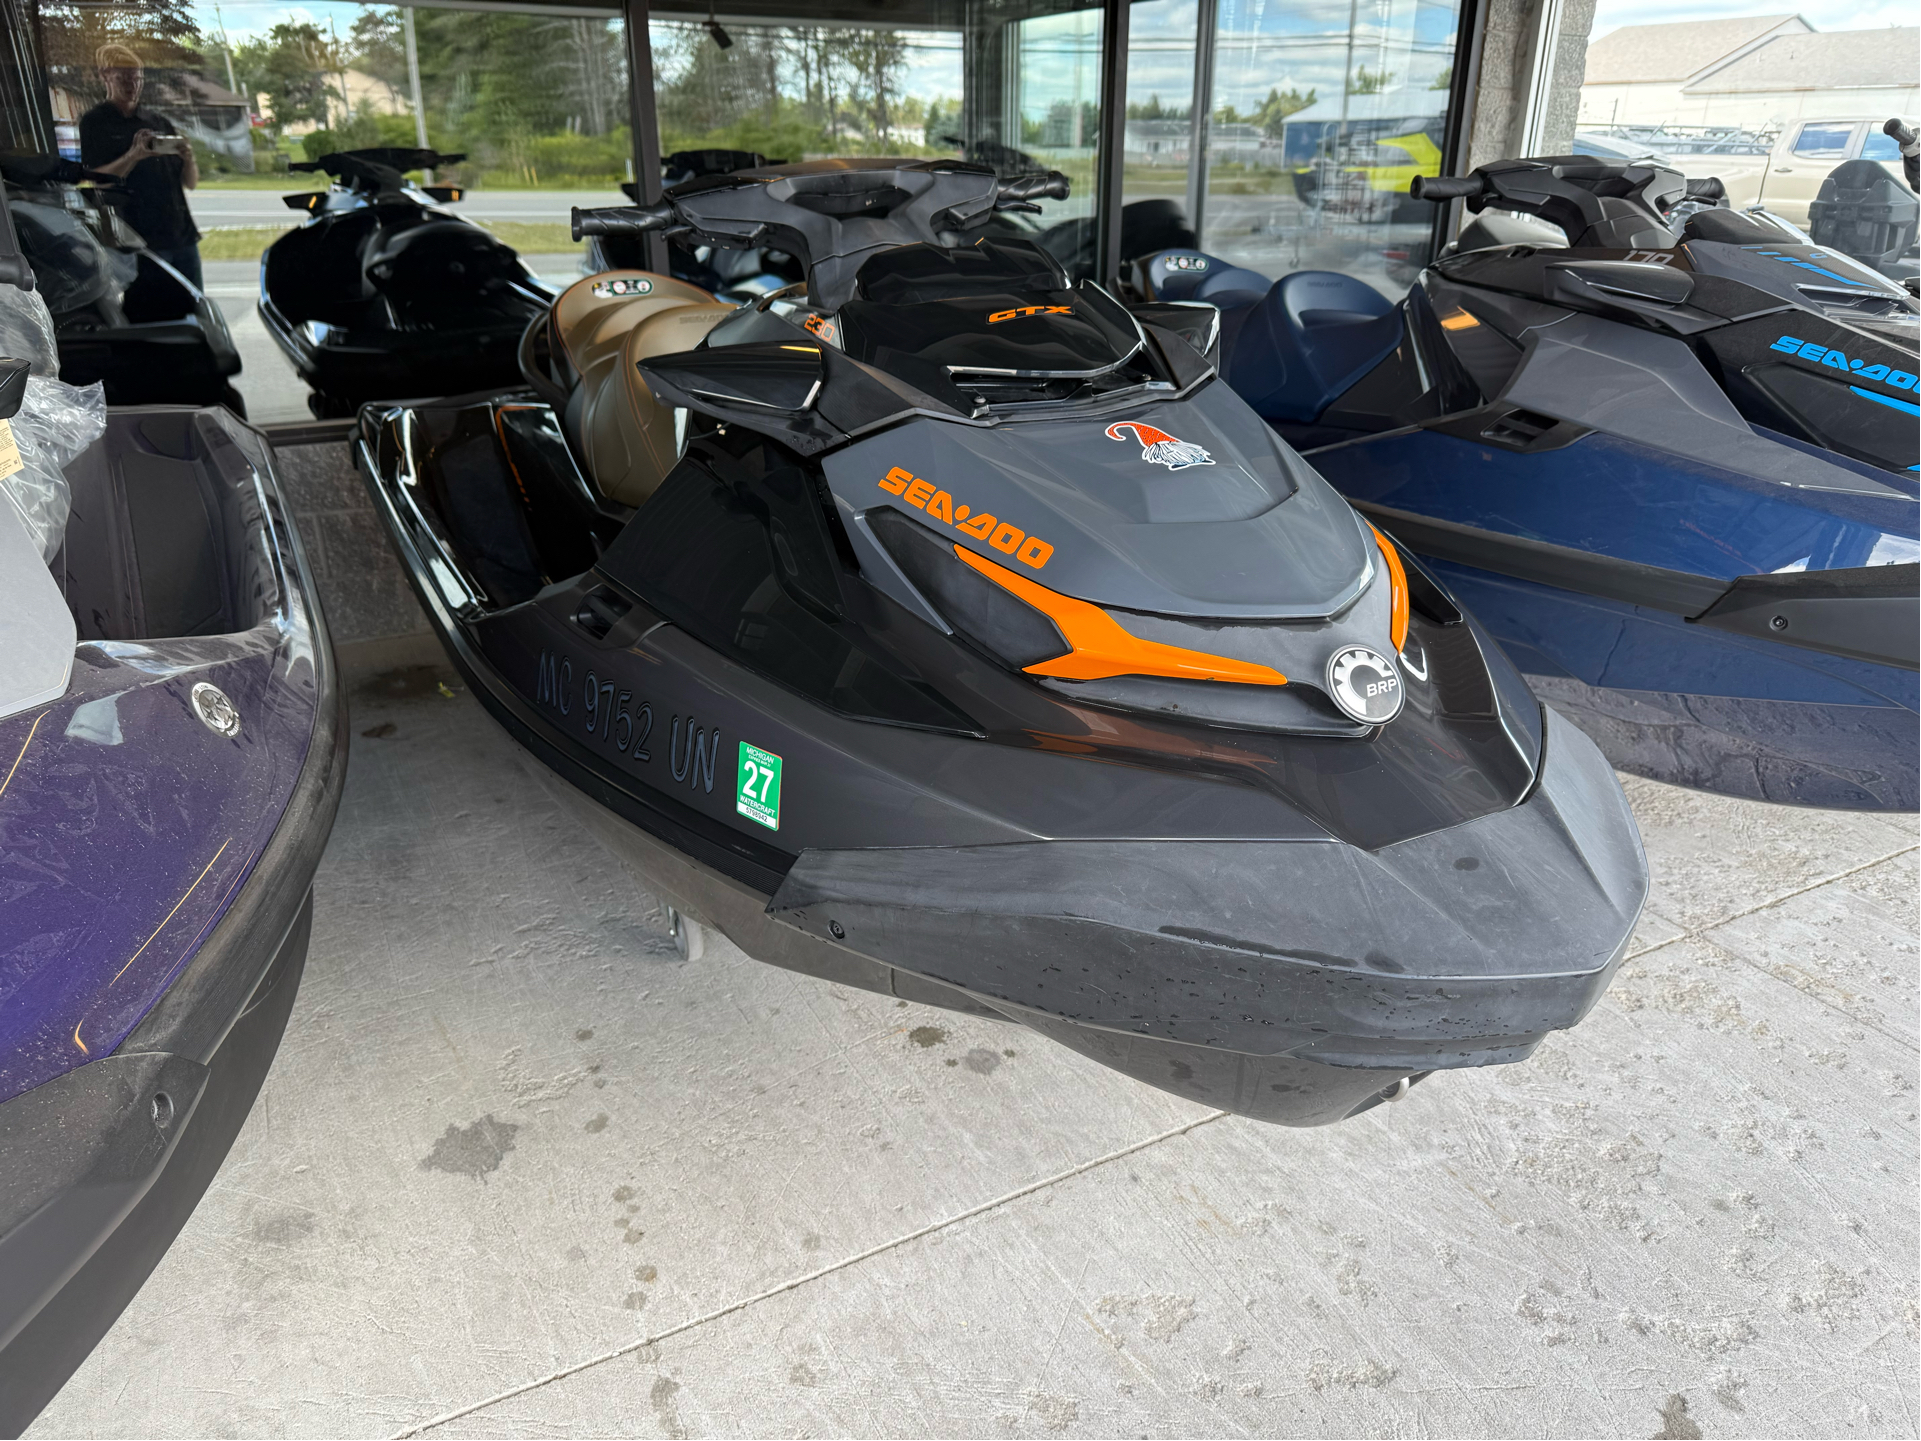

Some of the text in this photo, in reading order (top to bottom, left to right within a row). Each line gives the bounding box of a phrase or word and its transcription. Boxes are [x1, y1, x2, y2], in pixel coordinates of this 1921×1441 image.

[1622, 249, 1675, 265] 170
[987, 305, 1073, 323] GTX
[803, 313, 836, 342] 230
[1366, 678, 1397, 698] BRP
[537, 648, 721, 795] MC 9752 UN
[746, 746, 775, 765] MICHIGAN
[742, 760, 775, 803] 27
[739, 794, 776, 817] WATERCRAFT
